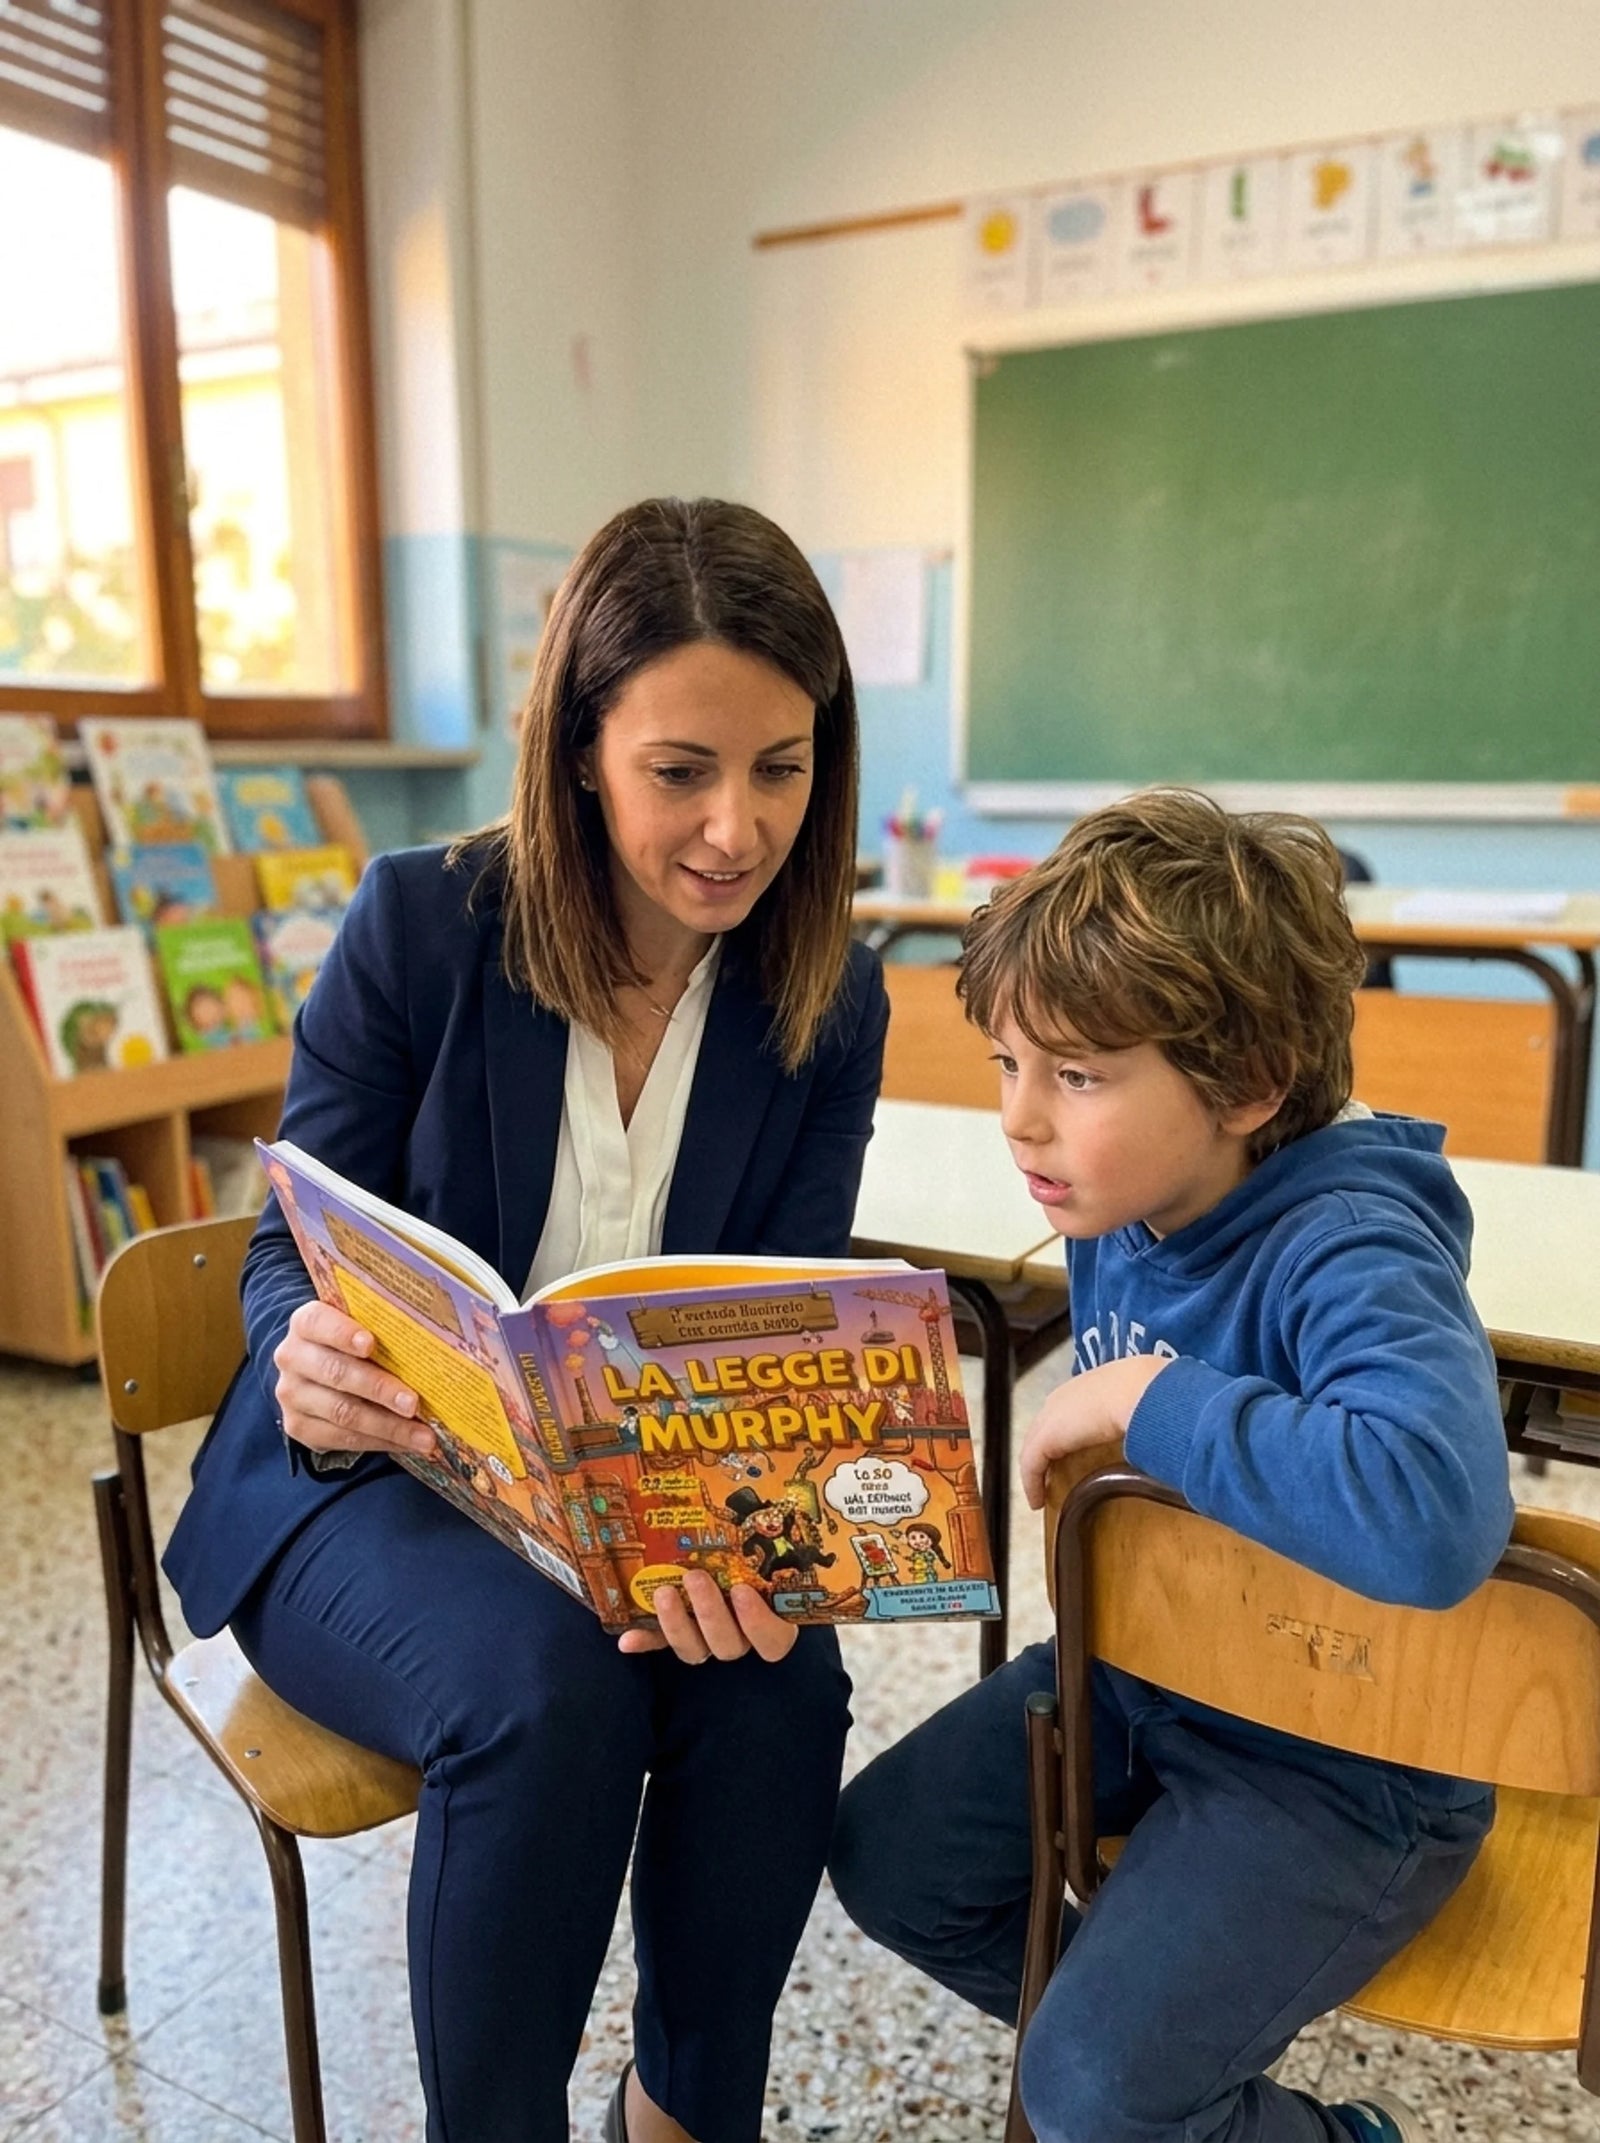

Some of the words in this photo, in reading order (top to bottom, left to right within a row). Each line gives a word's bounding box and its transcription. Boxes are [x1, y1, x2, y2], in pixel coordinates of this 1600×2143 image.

[602, 1361, 678, 1402] LA
[685, 1349, 852, 1394] LEGGE
[862, 1345, 919, 1388] DI
[639, 1401, 884, 1453] MURPHY
